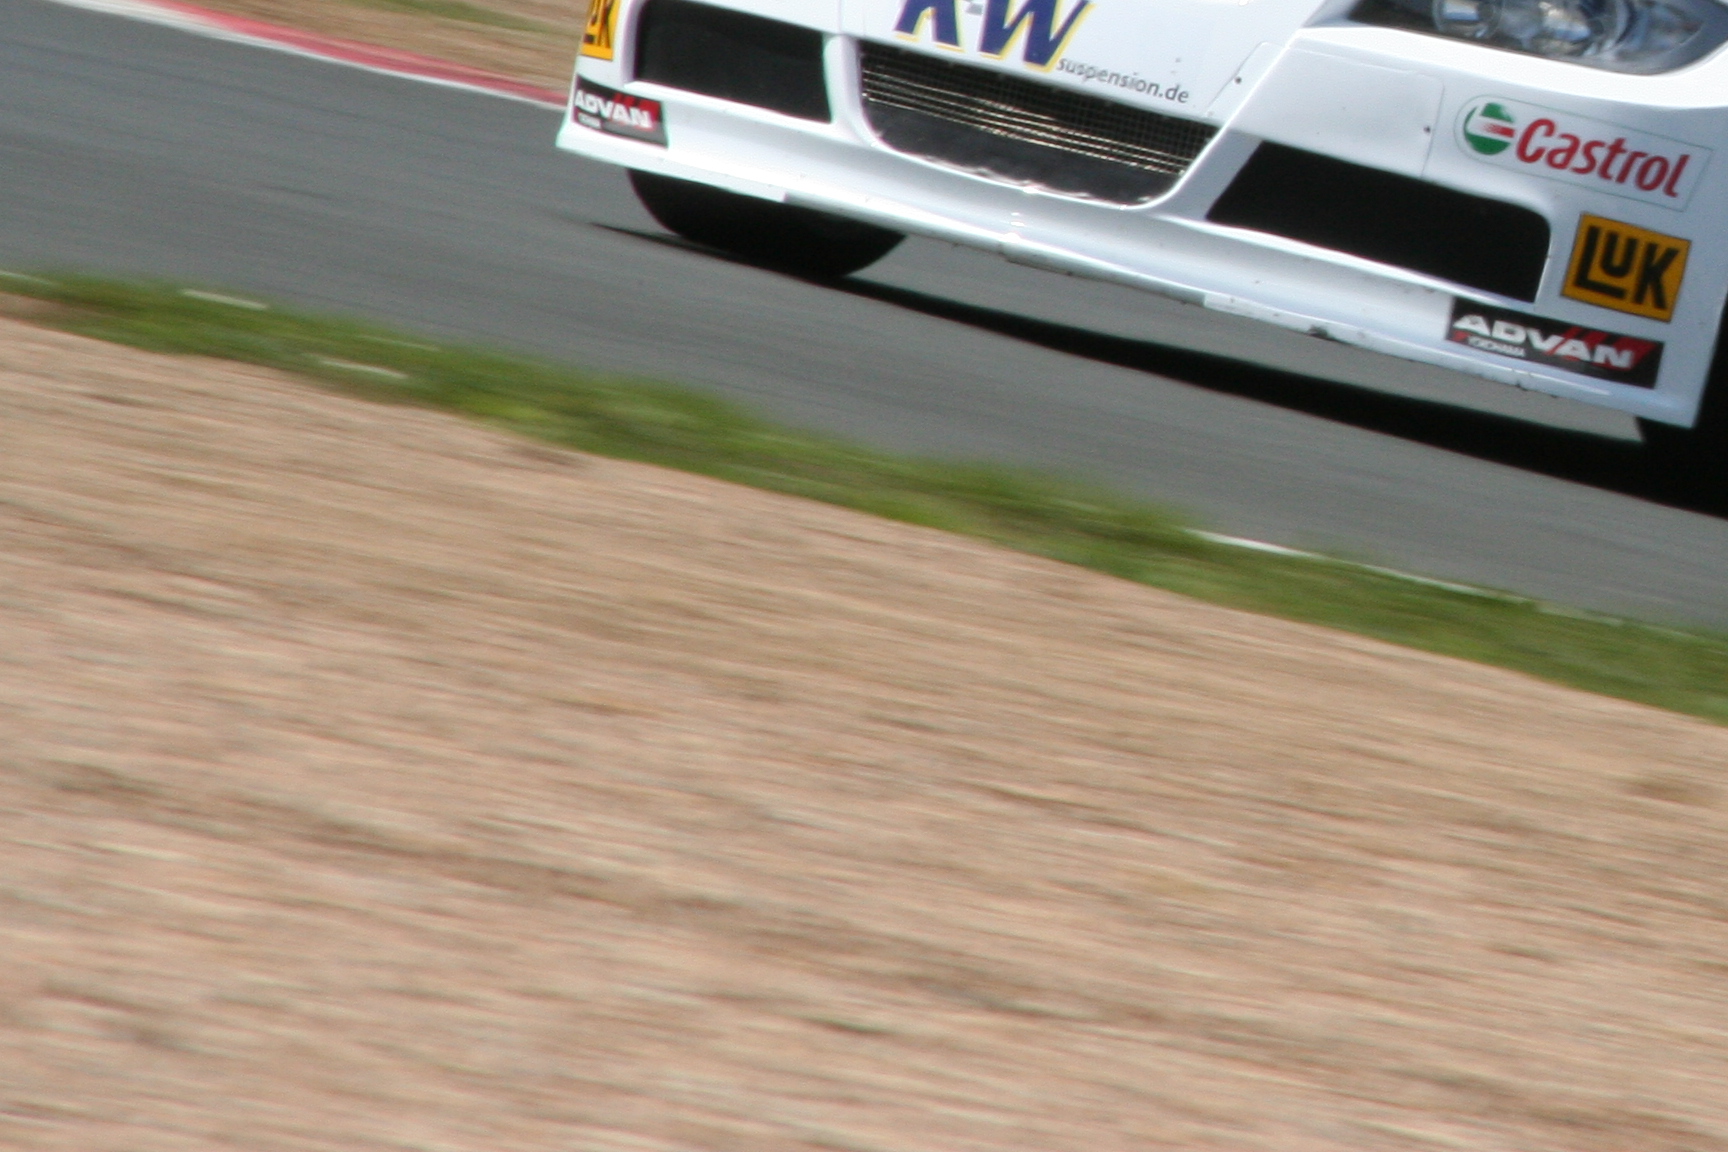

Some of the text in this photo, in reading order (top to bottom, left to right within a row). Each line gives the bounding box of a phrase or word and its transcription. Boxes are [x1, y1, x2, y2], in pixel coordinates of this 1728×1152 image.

[1057, 57, 1190, 104] suspension.de
[574, 89, 653, 129] ADVAN
[1516, 118, 1691, 198] Castrol
[1453, 314, 1636, 370] ADVAN
